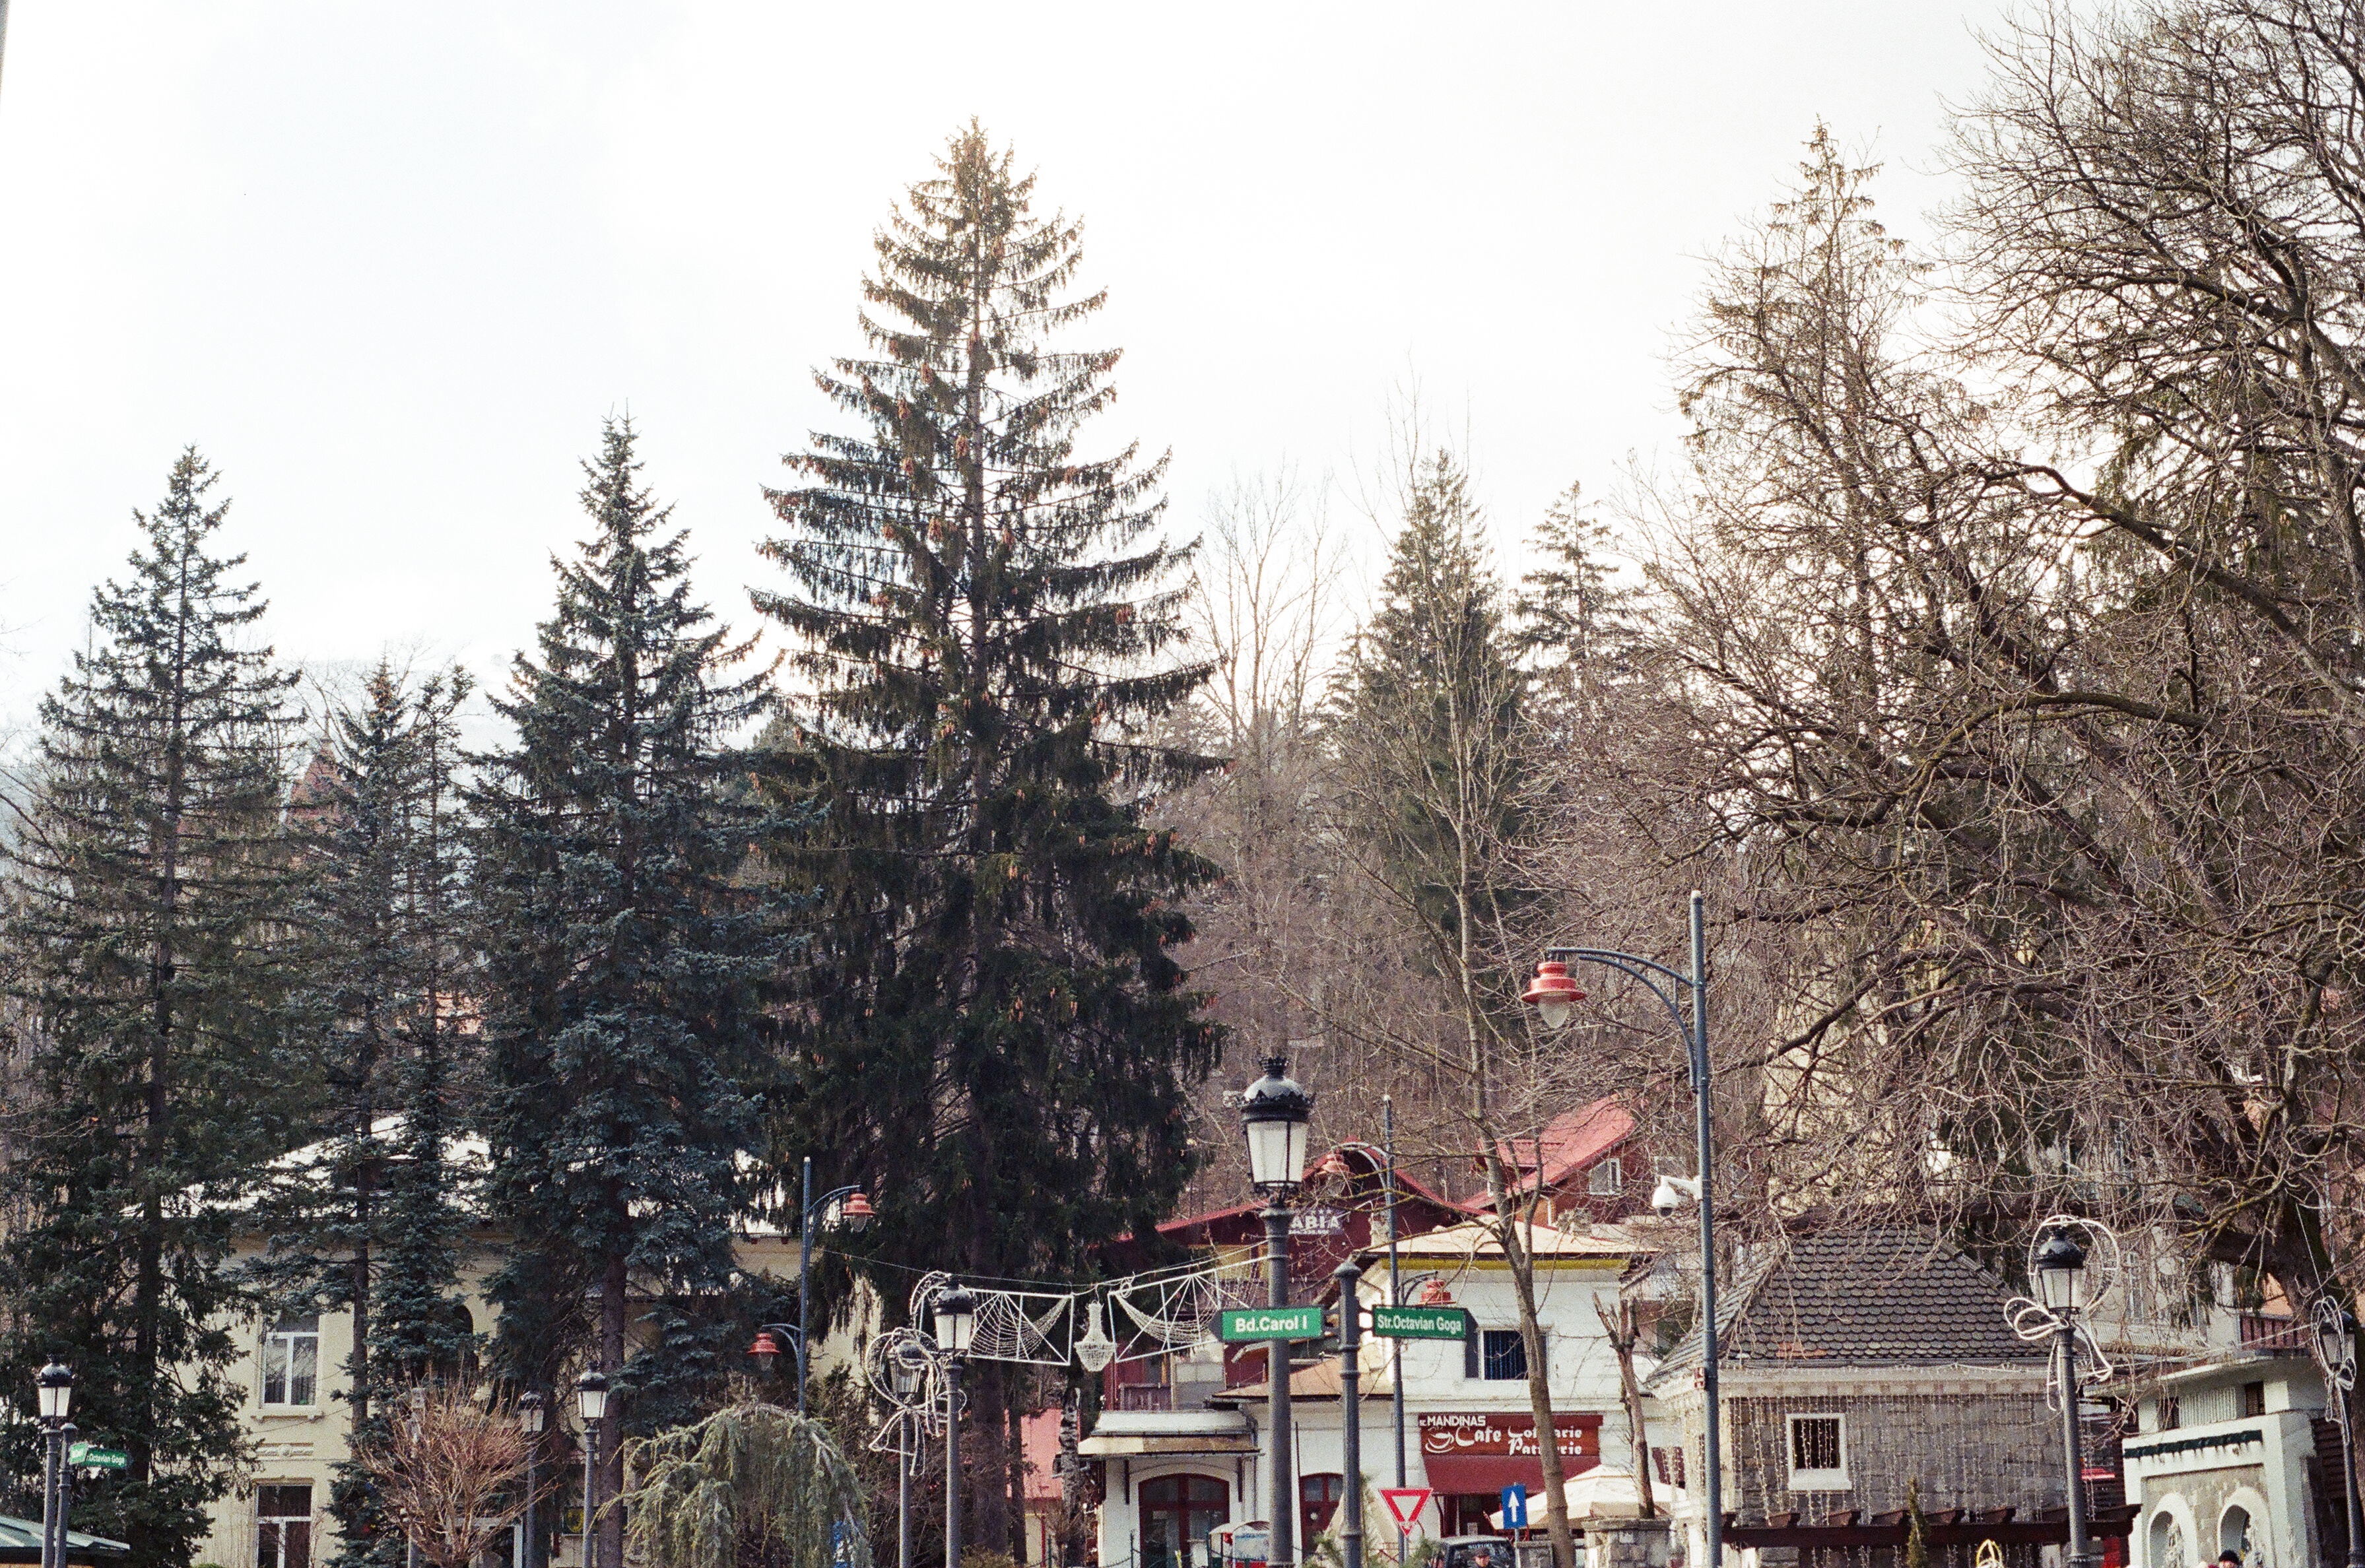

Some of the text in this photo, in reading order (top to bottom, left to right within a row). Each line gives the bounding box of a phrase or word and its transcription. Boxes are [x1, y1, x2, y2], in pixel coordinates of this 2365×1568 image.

[1235, 1315, 1308, 1332] Bd.Carol I
[1377, 1314, 1461, 1334] Str.Octavian Goga
[1427, 1416, 1486, 1427] MANDINAS
[1455, 1425, 1502, 1447] Cafe
[1508, 1425, 1582, 1439] Cofarie
